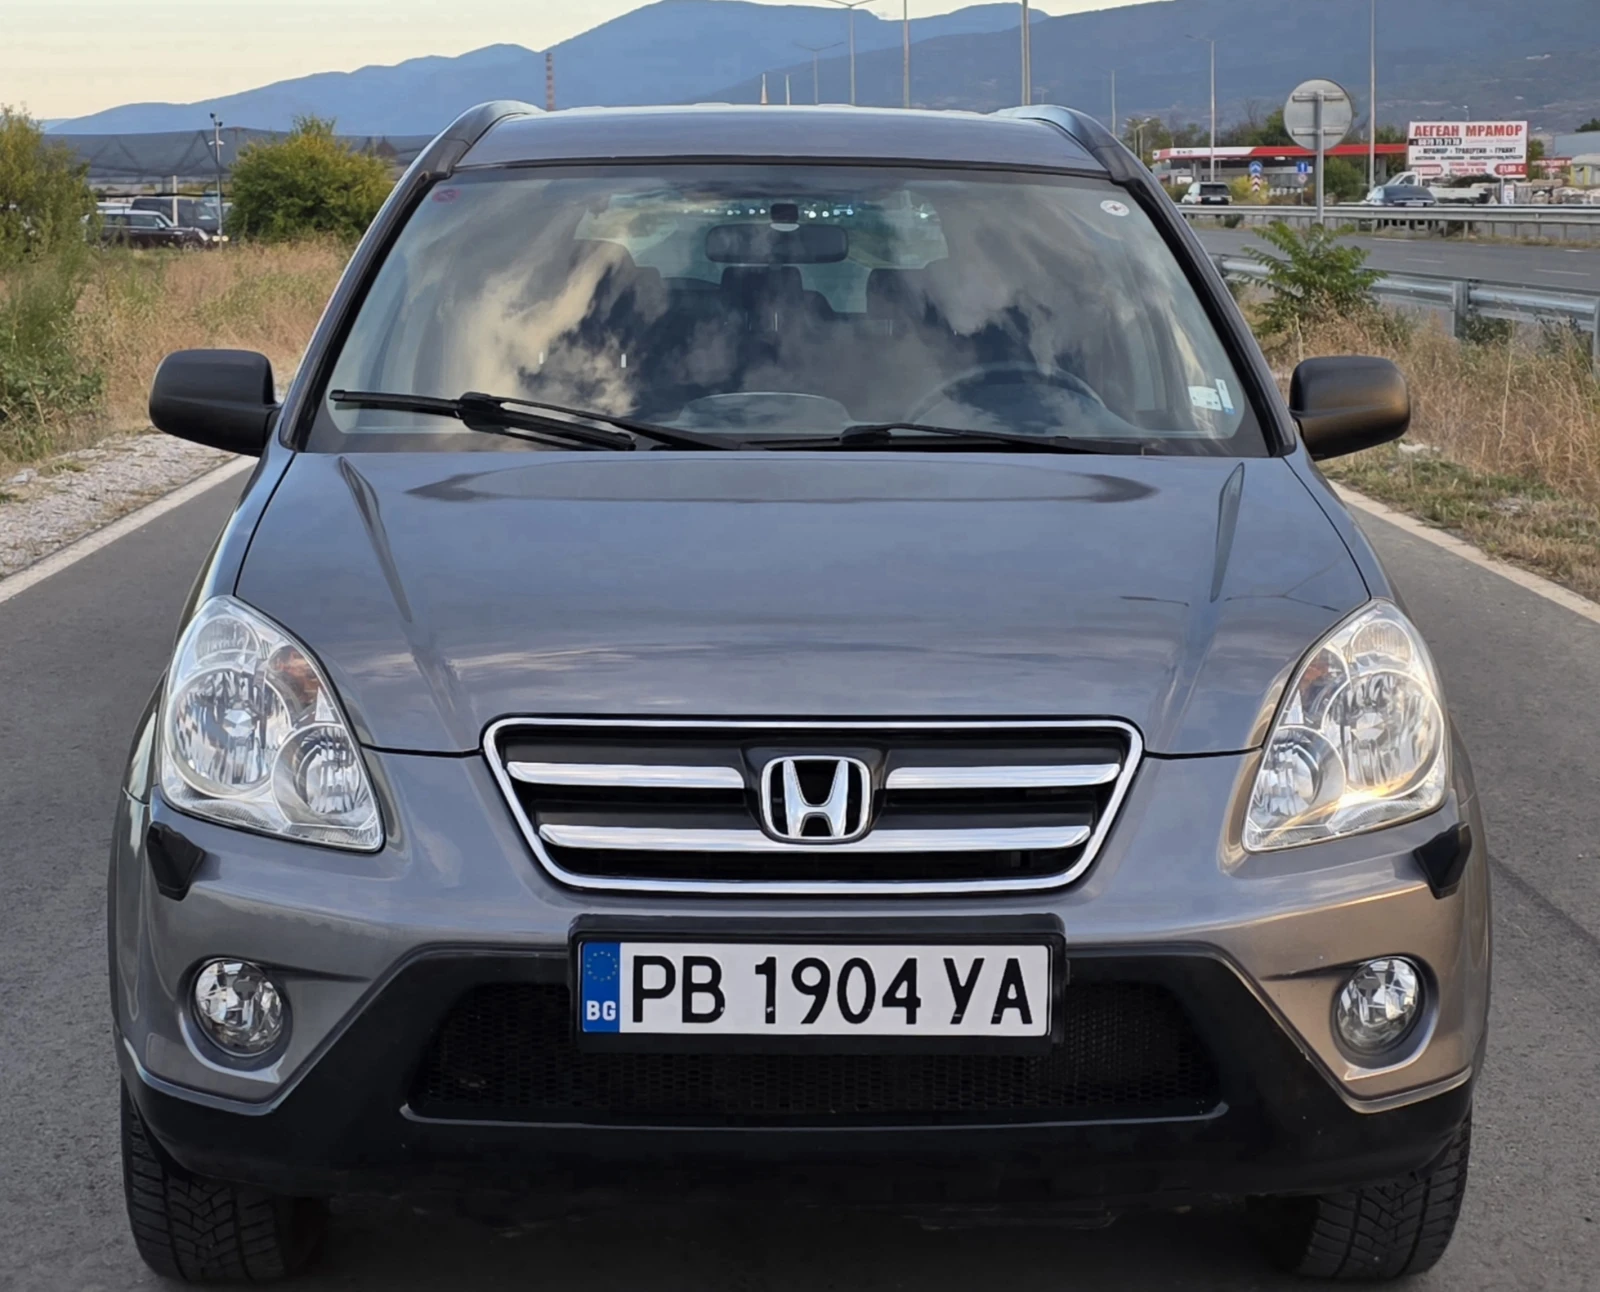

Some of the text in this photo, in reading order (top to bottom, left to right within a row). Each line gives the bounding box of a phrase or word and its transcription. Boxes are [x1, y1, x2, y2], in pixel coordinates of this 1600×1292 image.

[1414, 124, 1523, 137] АЕГЕАН МРАМОР
[632, 955, 726, 1024] PB
[755, 956, 922, 1025] 1904
[586, 1000, 617, 1021] BG
